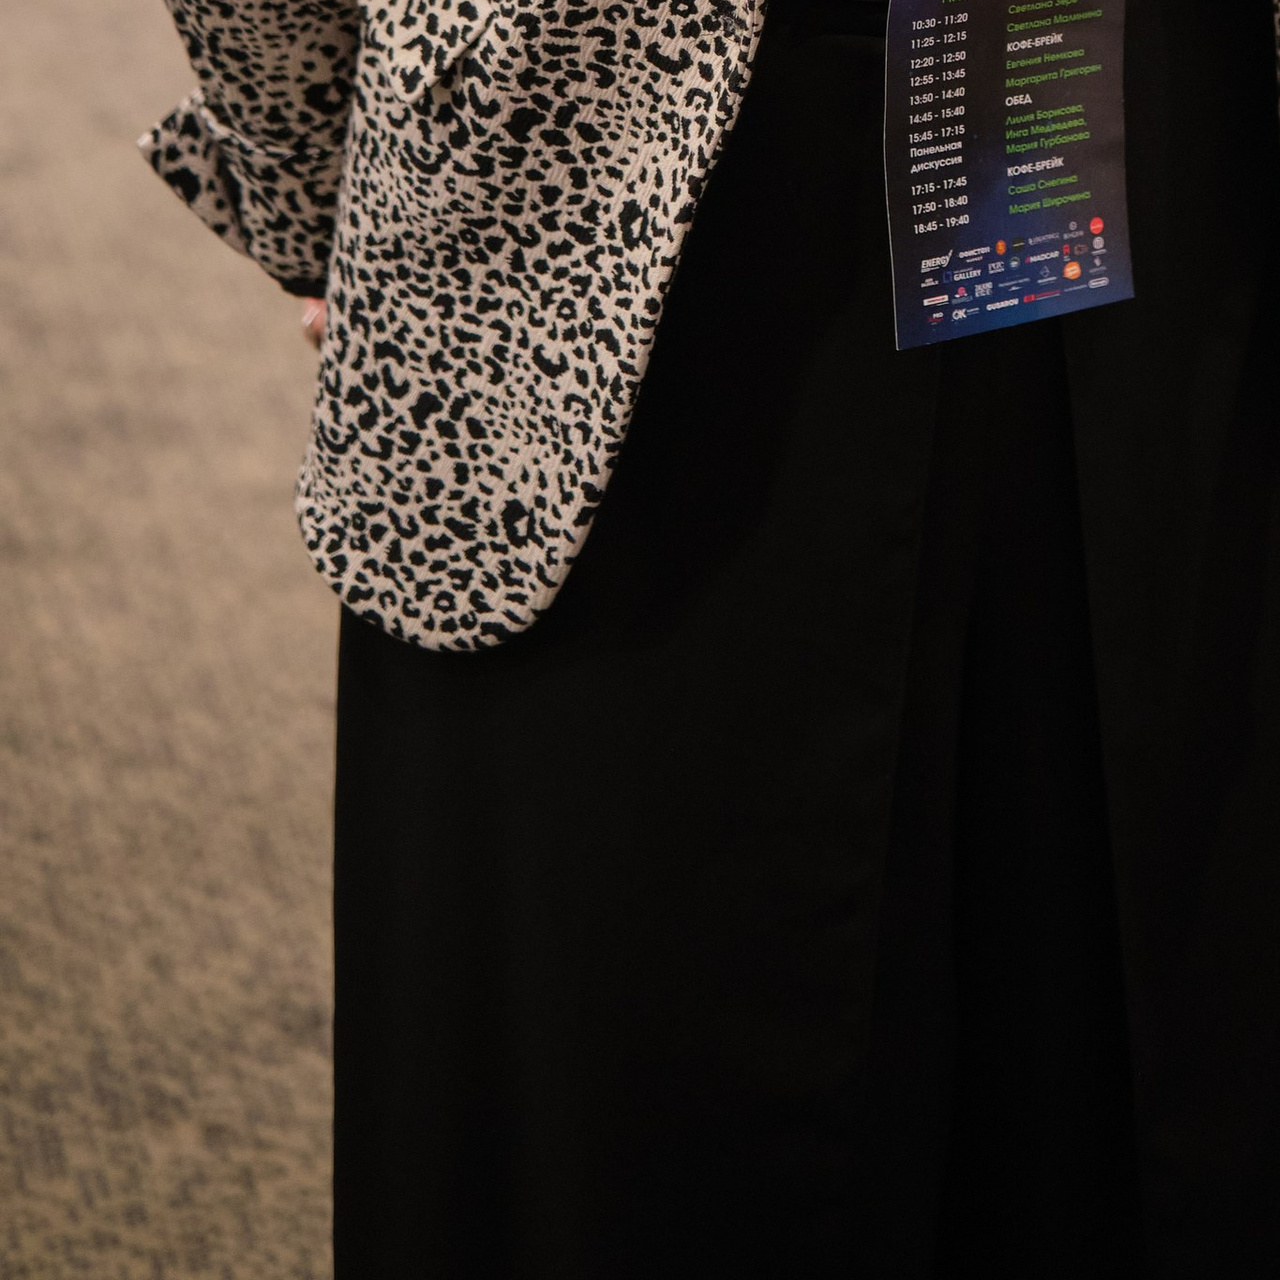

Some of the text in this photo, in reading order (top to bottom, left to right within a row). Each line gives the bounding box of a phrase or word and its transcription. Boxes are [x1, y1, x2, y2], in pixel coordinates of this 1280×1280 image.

[1008, 0, 1053, 14] Светлана
[912, 18, 936, 30] 10:30
[944, 13, 968, 25] 11:20
[1006, 19, 1051, 32] Светлана
[911, 37, 934, 49] 11:25
[943, 31, 967, 44] 12:15
[1006, 33, 1063, 52] КОФЕ-БРЕЙК
[910, 56, 934, 69] 12:20
[942, 51, 966, 63] 12:50
[910, 74, 934, 87] 12:55
[942, 68, 966, 81] 13:45
[1005, 72, 1058, 88] Маргарита
[910, 93, 934, 106] 13:50
[942, 87, 965, 100] 14:40
[1005, 93, 1032, 107] ОБЕД
[909, 111, 933, 125] 14:45
[941, 106, 965, 119] 15:40
[909, 130, 933, 144] 15:45
[941, 124, 965, 137] 17:15
[910, 141, 962, 158] Панельная
[1006, 141, 1038, 154] Мария
[1007, 156, 1064, 177] КОФЕ-БРЕЙК
[911, 182, 935, 196] 17:15
[943, 176, 967, 189] 17:45
[912, 201, 936, 215] 17:50
[944, 195, 968, 208] 18:40
[1009, 202, 1041, 215] Мария
[914, 221, 938, 234] 18:45
[945, 214, 970, 228] 19:40
[921, 249, 953, 268] ENERGY
[953, 269, 982, 281] GALLERY
